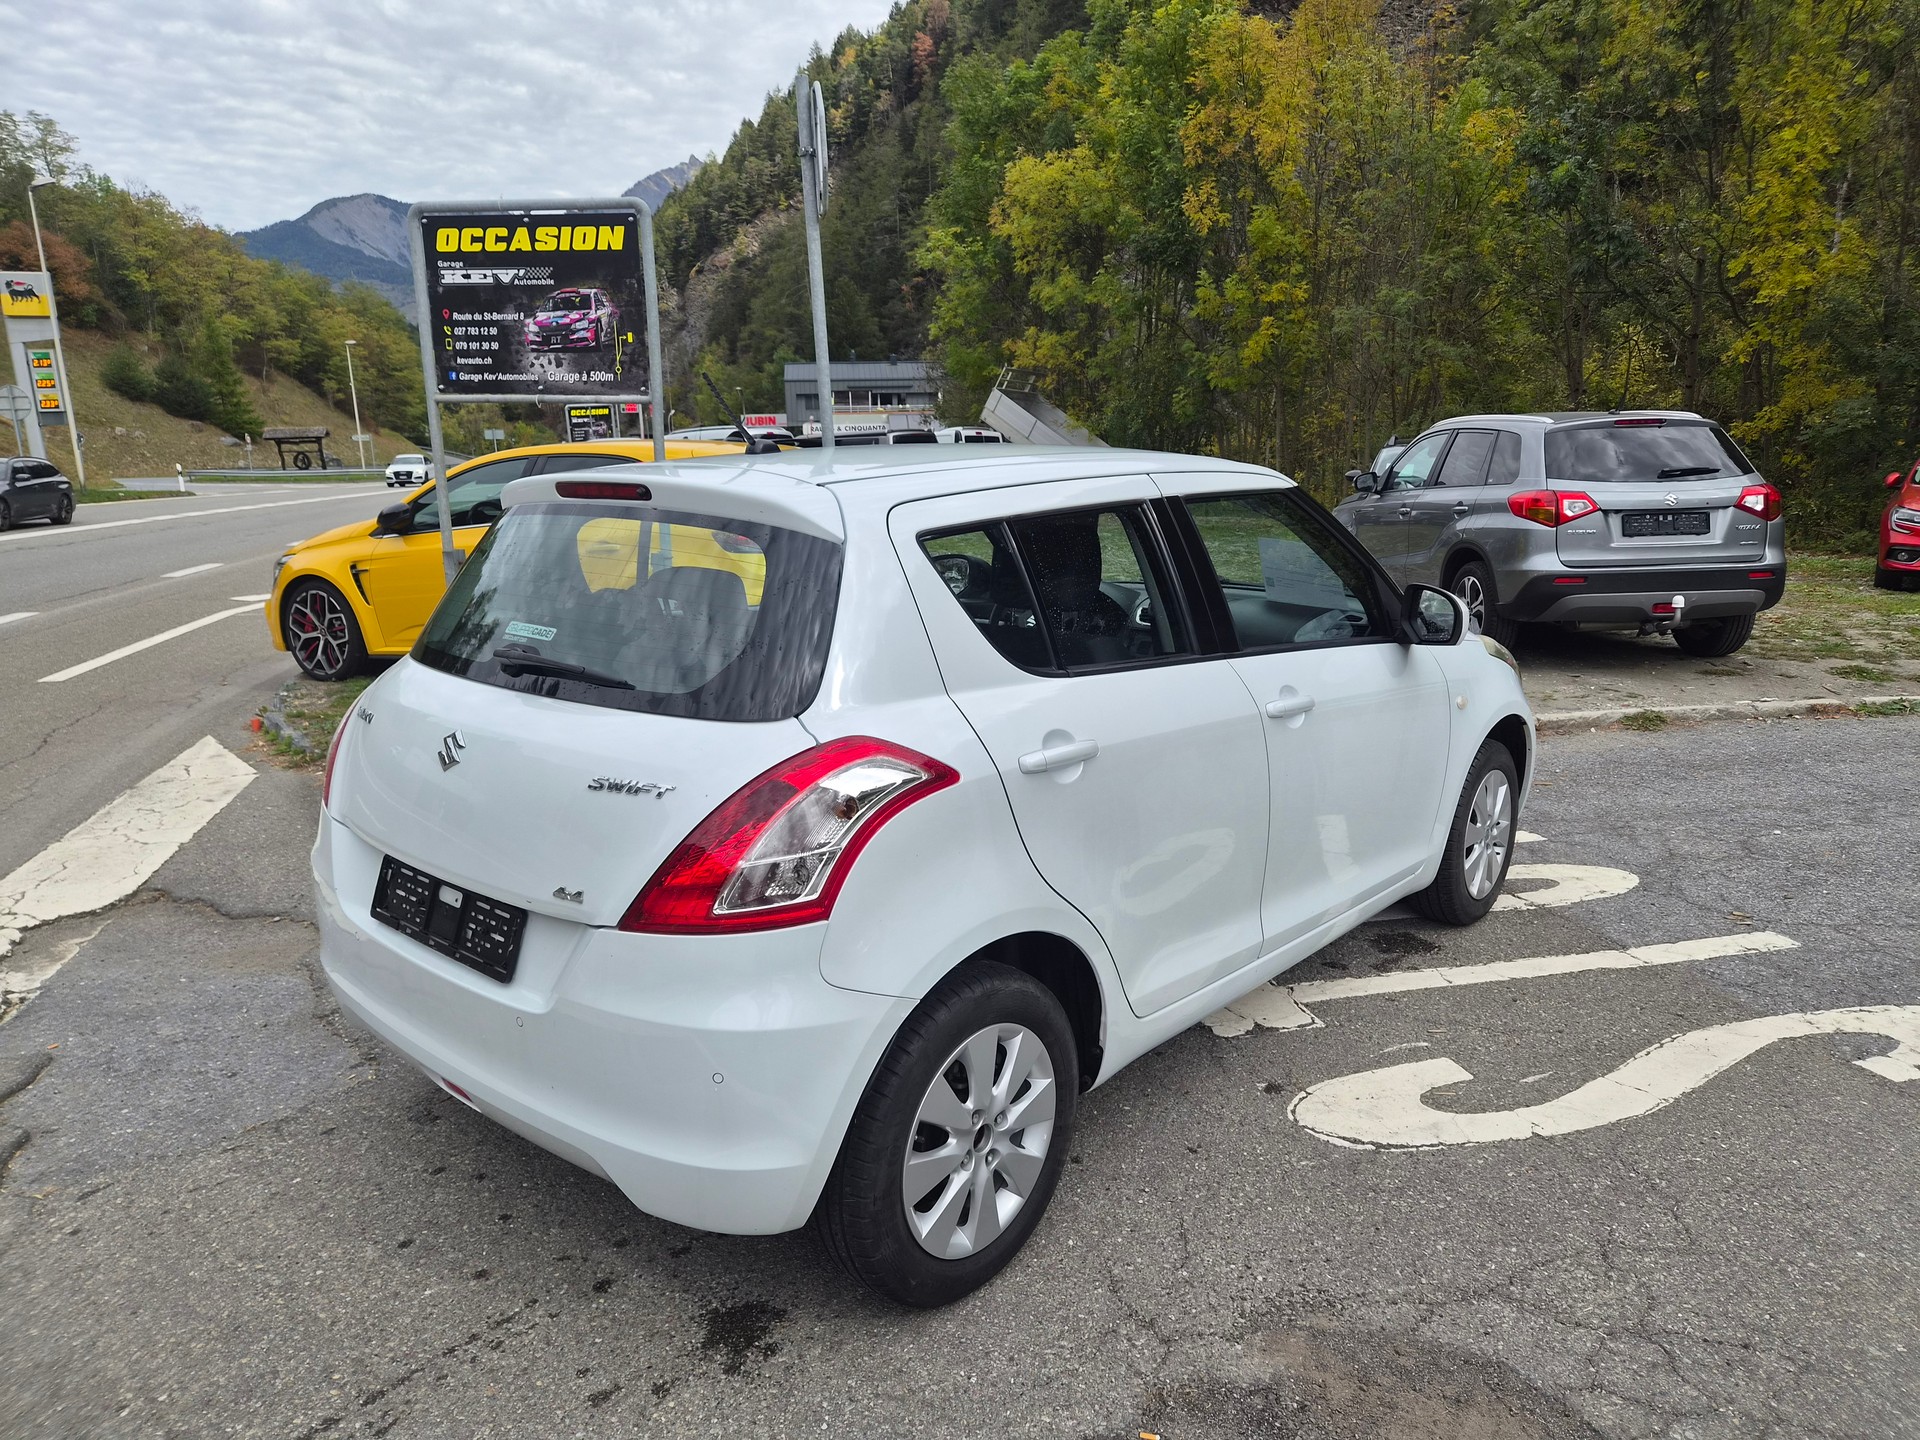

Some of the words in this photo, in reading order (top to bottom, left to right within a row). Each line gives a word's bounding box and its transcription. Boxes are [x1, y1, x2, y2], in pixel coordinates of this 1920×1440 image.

[436, 226, 625, 252] OCCASION
[437, 260, 464, 269] Garage
[452, 312, 473, 321] Route
[473, 312, 483, 321] du
[483, 312, 519, 321] St-Bernard
[454, 327, 466, 335] 027
[480, 327, 488, 335] 12
[489, 327, 498, 335] 50
[455, 342, 467, 350] 079
[468, 342, 480, 350] 101
[481, 342, 490, 350] 30
[490, 342, 499, 350] 50
[456, 356, 493, 365] kevauto.ch
[459, 372, 483, 382] Garage
[547, 371, 580, 383] Garage
[581, 370, 588, 380] à
[589, 371, 614, 380] 500m
[570, 408, 609, 416] OCCASION
[587, 776, 677, 799] SWIFT
